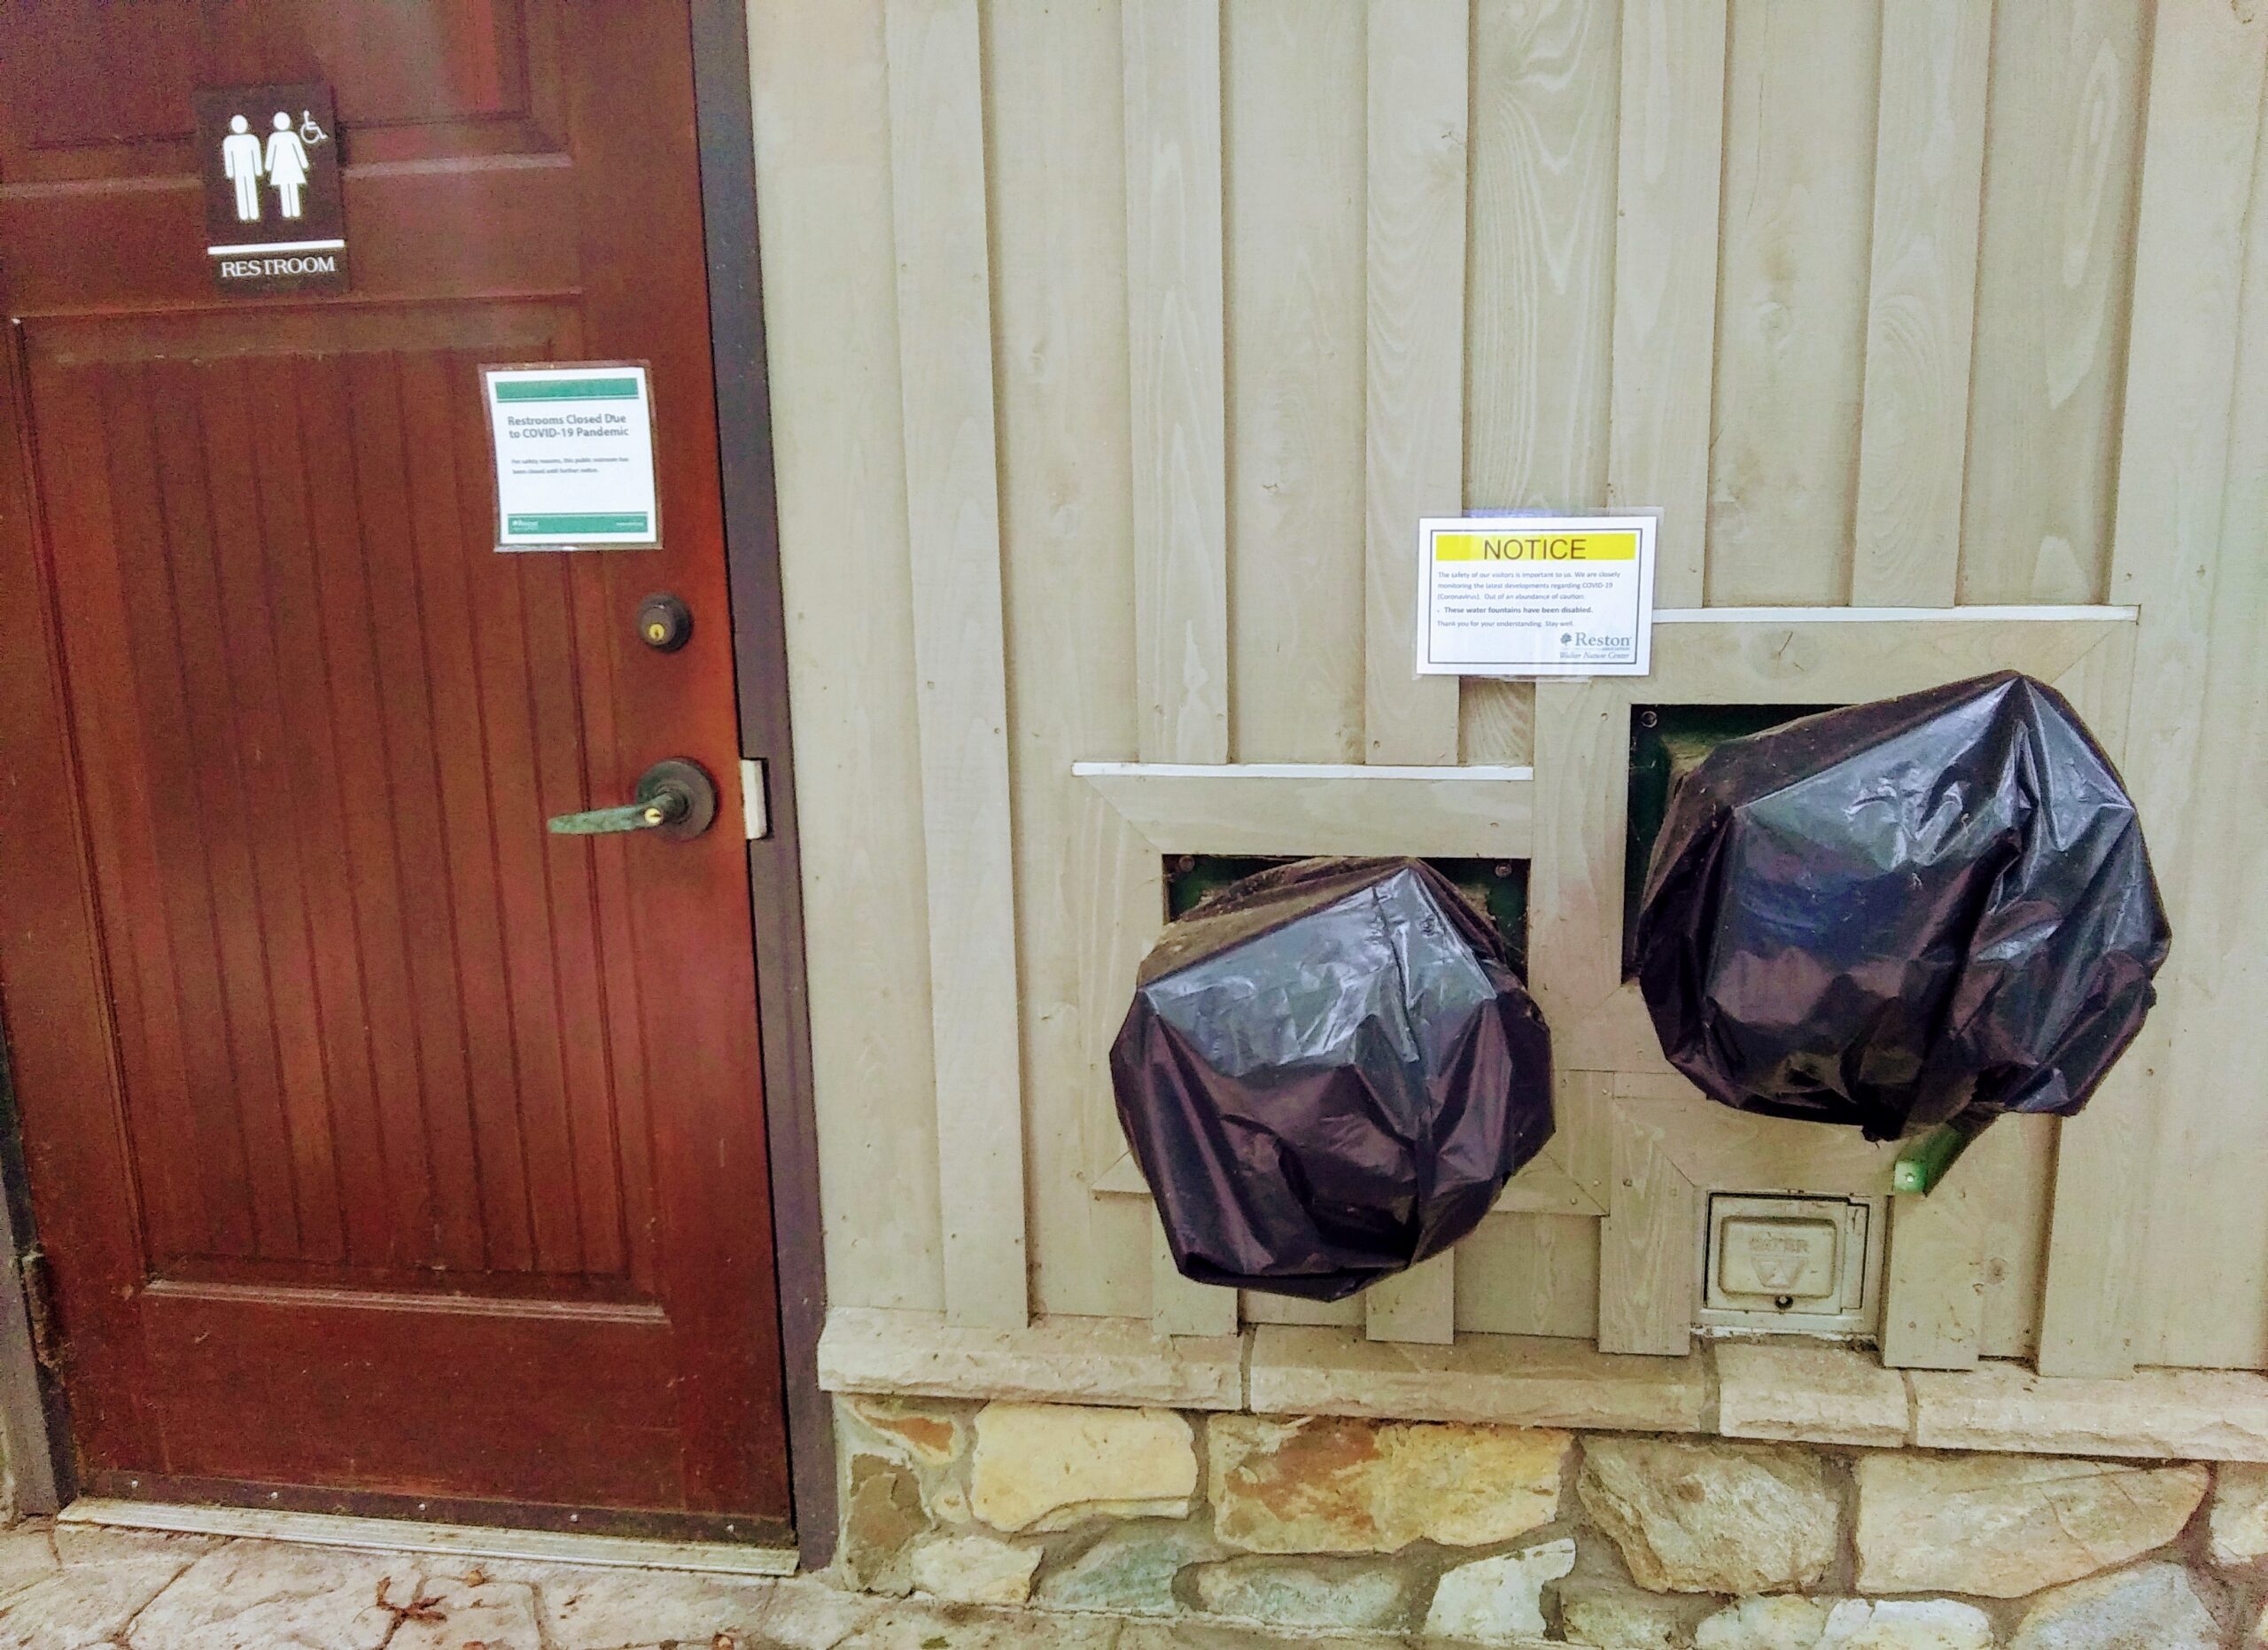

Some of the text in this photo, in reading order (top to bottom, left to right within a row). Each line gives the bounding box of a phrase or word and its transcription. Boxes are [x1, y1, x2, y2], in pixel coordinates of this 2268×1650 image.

[221, 256, 336, 277] RESTROOM
[508, 413, 626, 425] Restrooms Closed Due
[509, 426, 629, 439] to COVID-19 Pandemic
[1484, 539, 1587, 560] NOTICE
[1574, 632, 1629, 646] Reston
